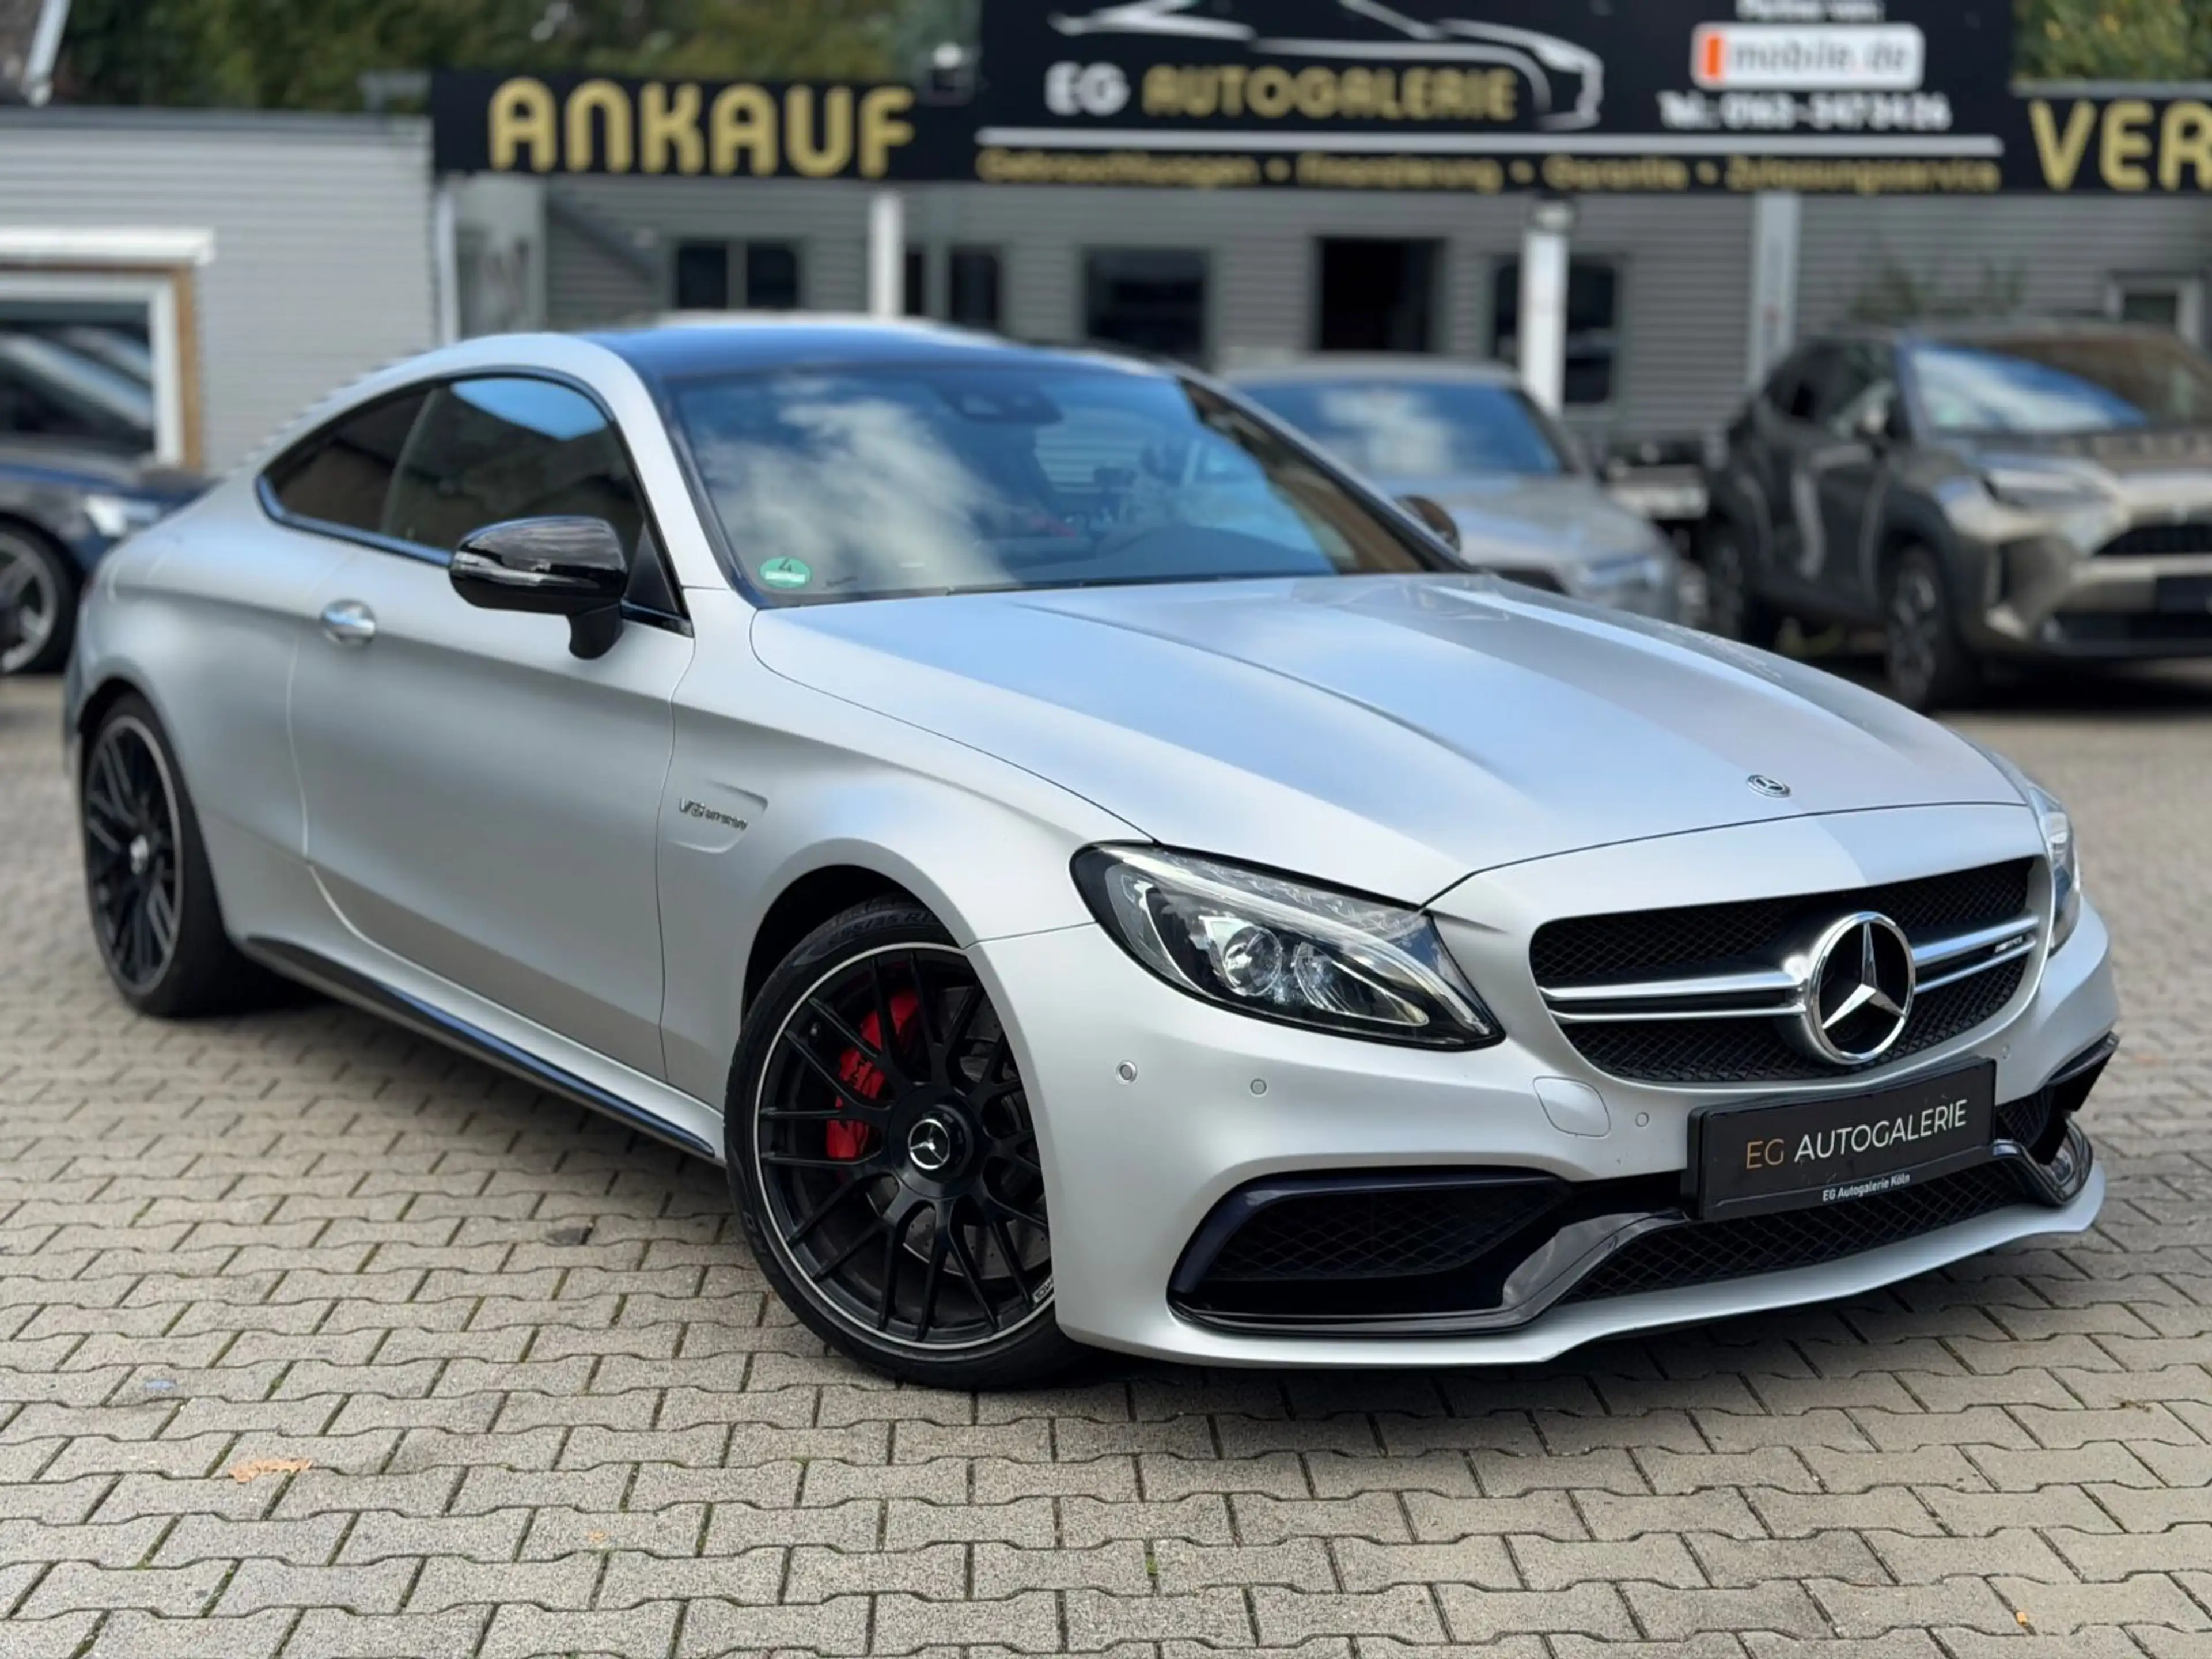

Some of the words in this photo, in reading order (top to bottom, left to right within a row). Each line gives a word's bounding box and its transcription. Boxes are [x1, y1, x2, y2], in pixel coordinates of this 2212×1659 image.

[1045, 62, 1130, 116] EG
[1142, 65, 1517, 119] AUTOGALERIE
[488, 77, 916, 179] ANKAUF
[779, 559, 792, 572] 4
[1745, 1138, 1785, 1169] EG
[1794, 1099, 1968, 1162] AUTOGALERIE
[1823, 1188, 1836, 1202] EG
[1837, 1178, 1890, 1199] Autogalerie
[1891, 1172, 1910, 1187] Köln
